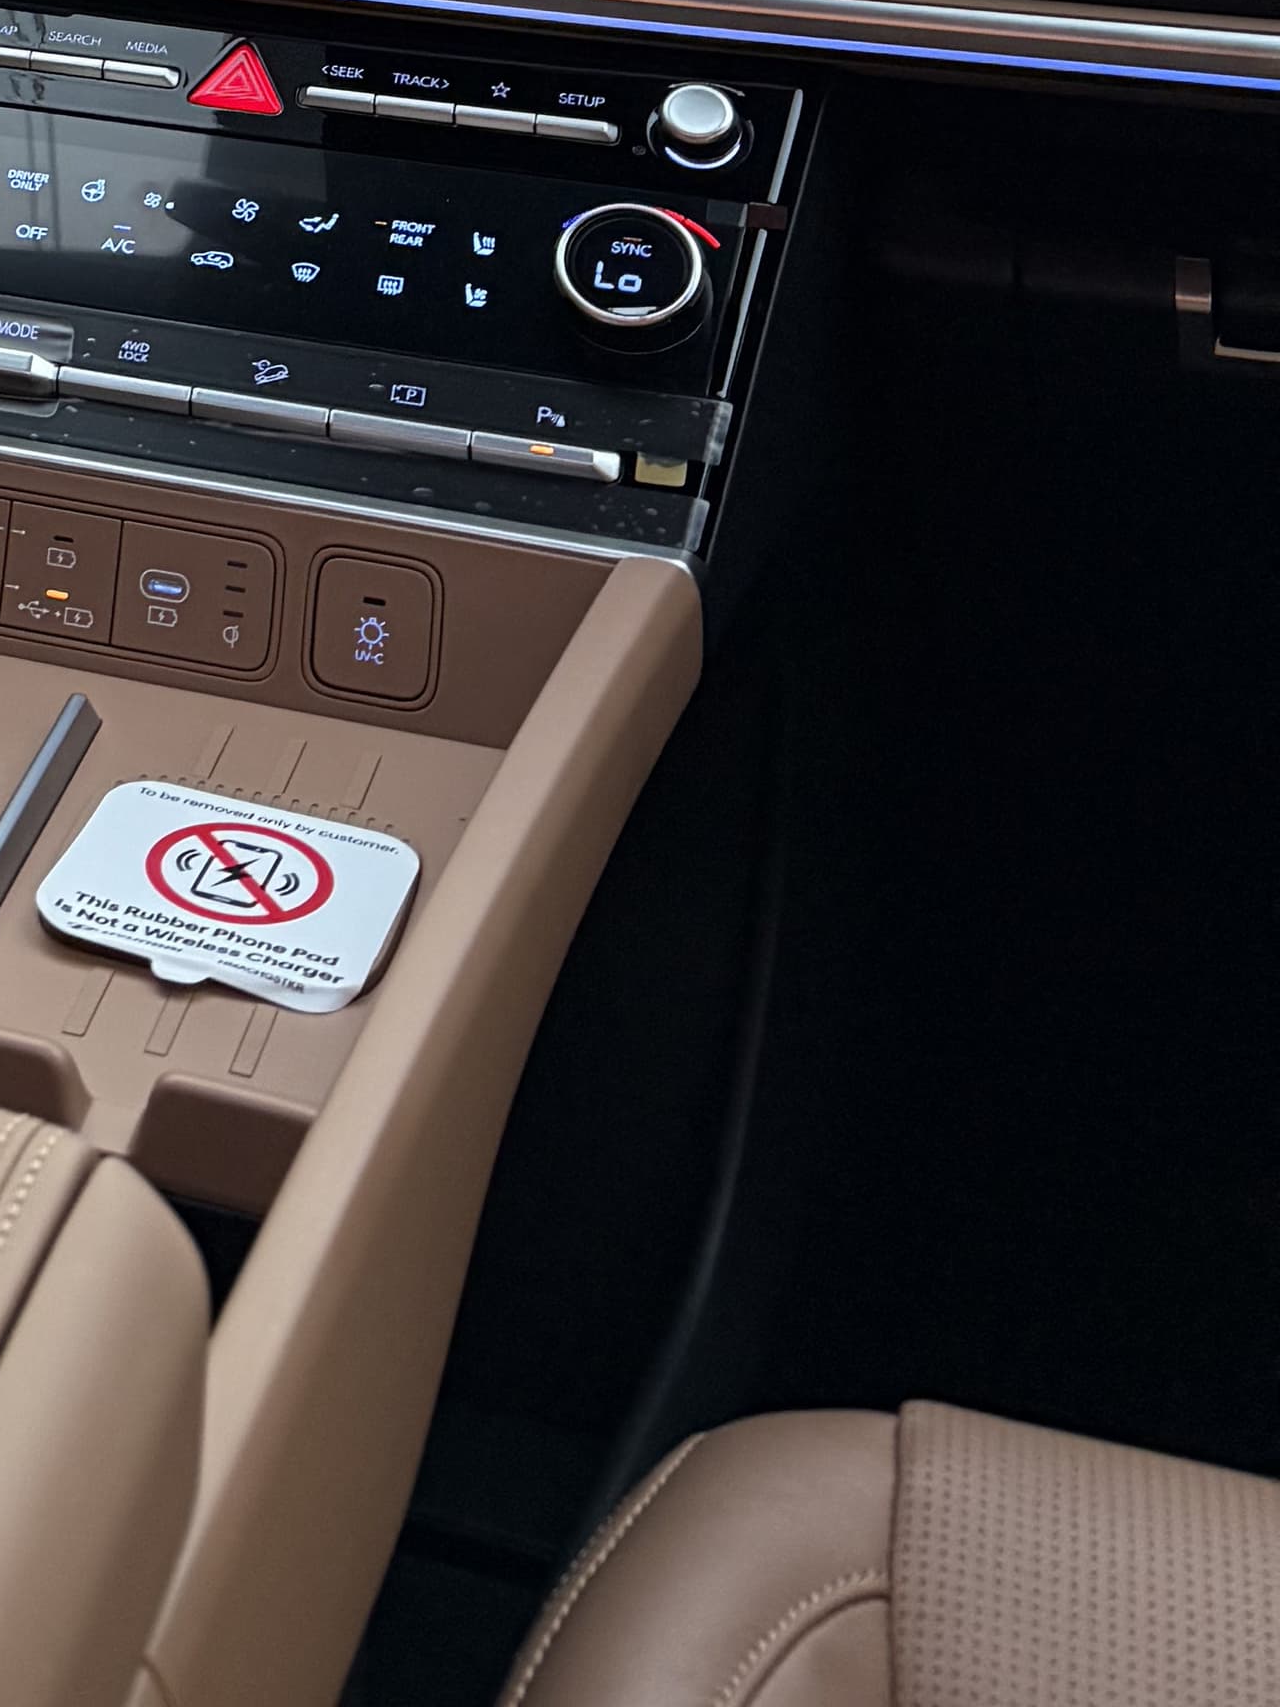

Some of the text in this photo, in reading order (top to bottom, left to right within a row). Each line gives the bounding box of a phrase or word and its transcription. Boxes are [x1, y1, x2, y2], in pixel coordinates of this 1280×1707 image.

[48, 30, 102, 47] SEARCH
[125, 41, 169, 55] MEDIA
[558, 92, 606, 108] SETUP
[7, 169, 49, 184] DRIVER
[9, 180, 42, 192] ONLY
[15, 224, 48, 240] OFF
[391, 220, 436, 235] FRONT
[100, 238, 136, 255] A/C
[389, 233, 424, 247] REAR
[611, 241, 652, 258] SYNC
[594, 260, 642, 293] Lo
[121, 340, 150, 354] 4WD
[118, 350, 149, 363] LOCK
[355, 649, 384, 665] UV-C
[138, 786, 158, 797] To
[159, 790, 180, 803] be
[183, 796, 256, 821] removed
[257, 815, 292, 830] only
[294, 822, 315, 836] by
[75, 891, 120, 912] This
[123, 904, 210, 934] Rubber
[212, 927, 288, 955] Phone
[290, 946, 341, 967] Pad
[54, 898, 72, 914] Is
[74, 903, 122, 925] Not
[123, 922, 139, 934] a
[145, 926, 241, 958] Wireless
[245, 951, 345, 986] Charger
